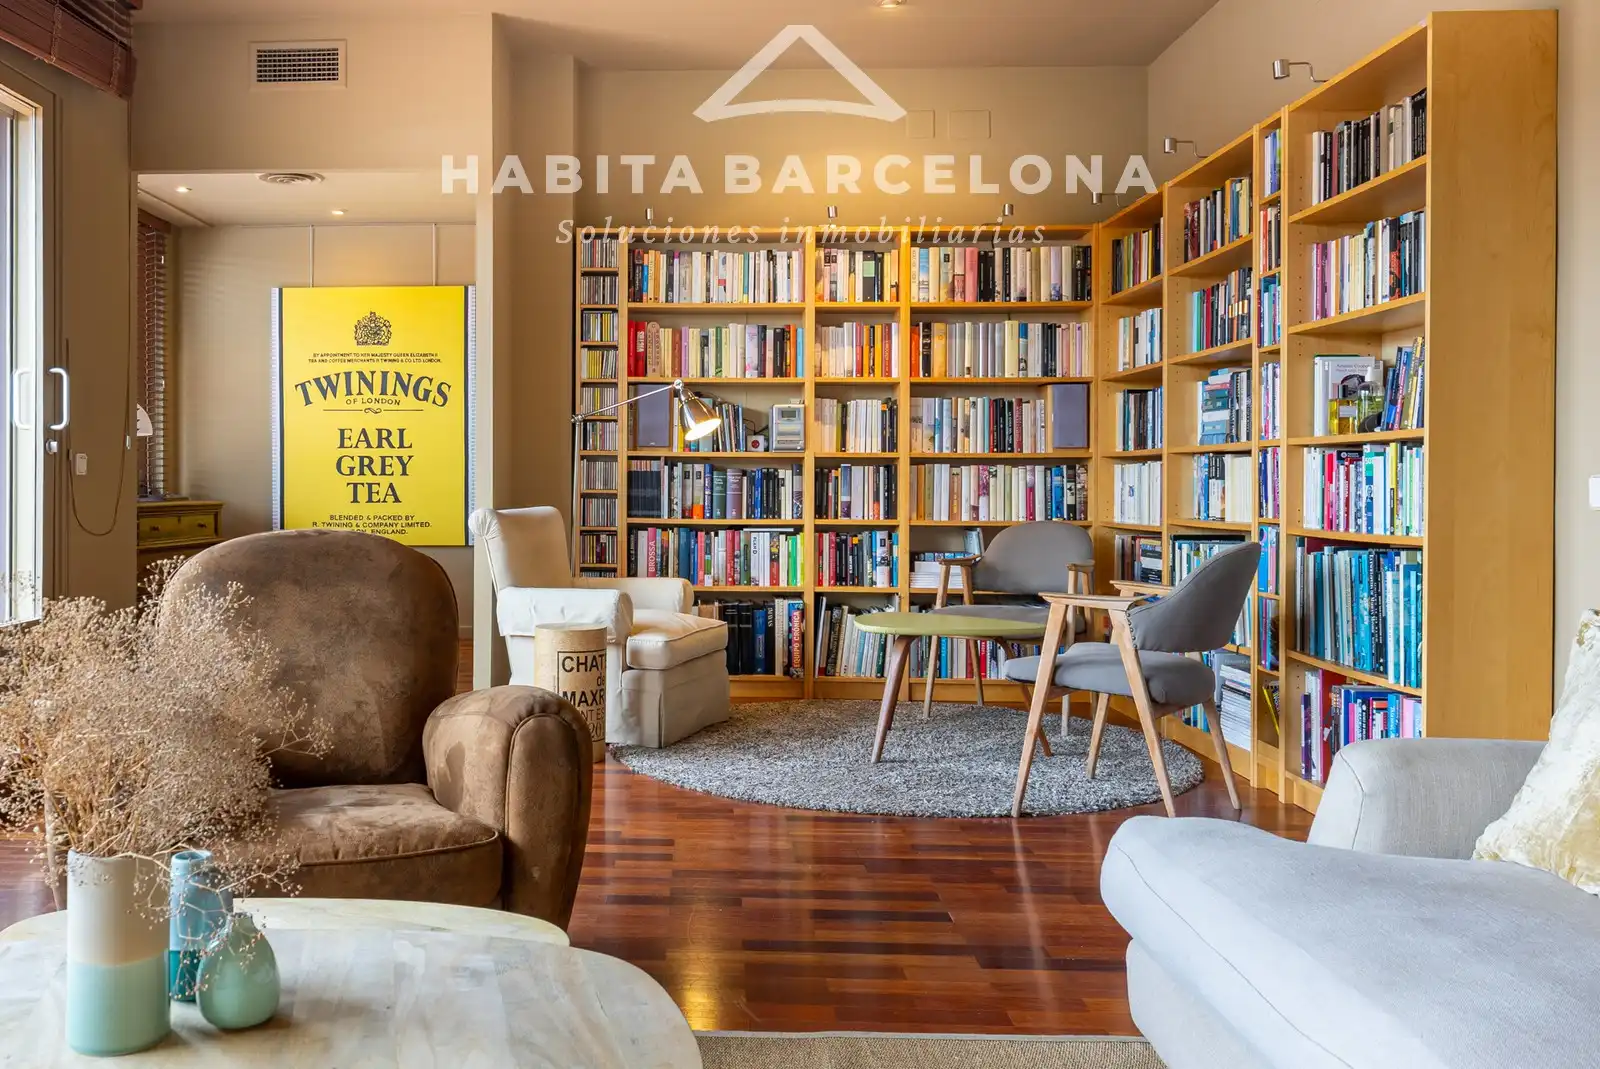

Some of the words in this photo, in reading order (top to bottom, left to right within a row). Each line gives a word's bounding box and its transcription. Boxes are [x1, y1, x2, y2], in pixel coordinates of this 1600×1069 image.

[295, 370, 452, 408] TWININGS
[346, 398, 358, 406] OF
[361, 398, 401, 406] LONDON
[337, 428, 412, 449] EARL
[336, 454, 414, 477] GREY
[346, 482, 402, 504] TEA
[648, 540, 656, 572] BROSSA
[792, 610, 801, 641] CRÓNICA
[562, 654, 606, 672] CHAT
[793, 642, 801, 668] EQUIPO
